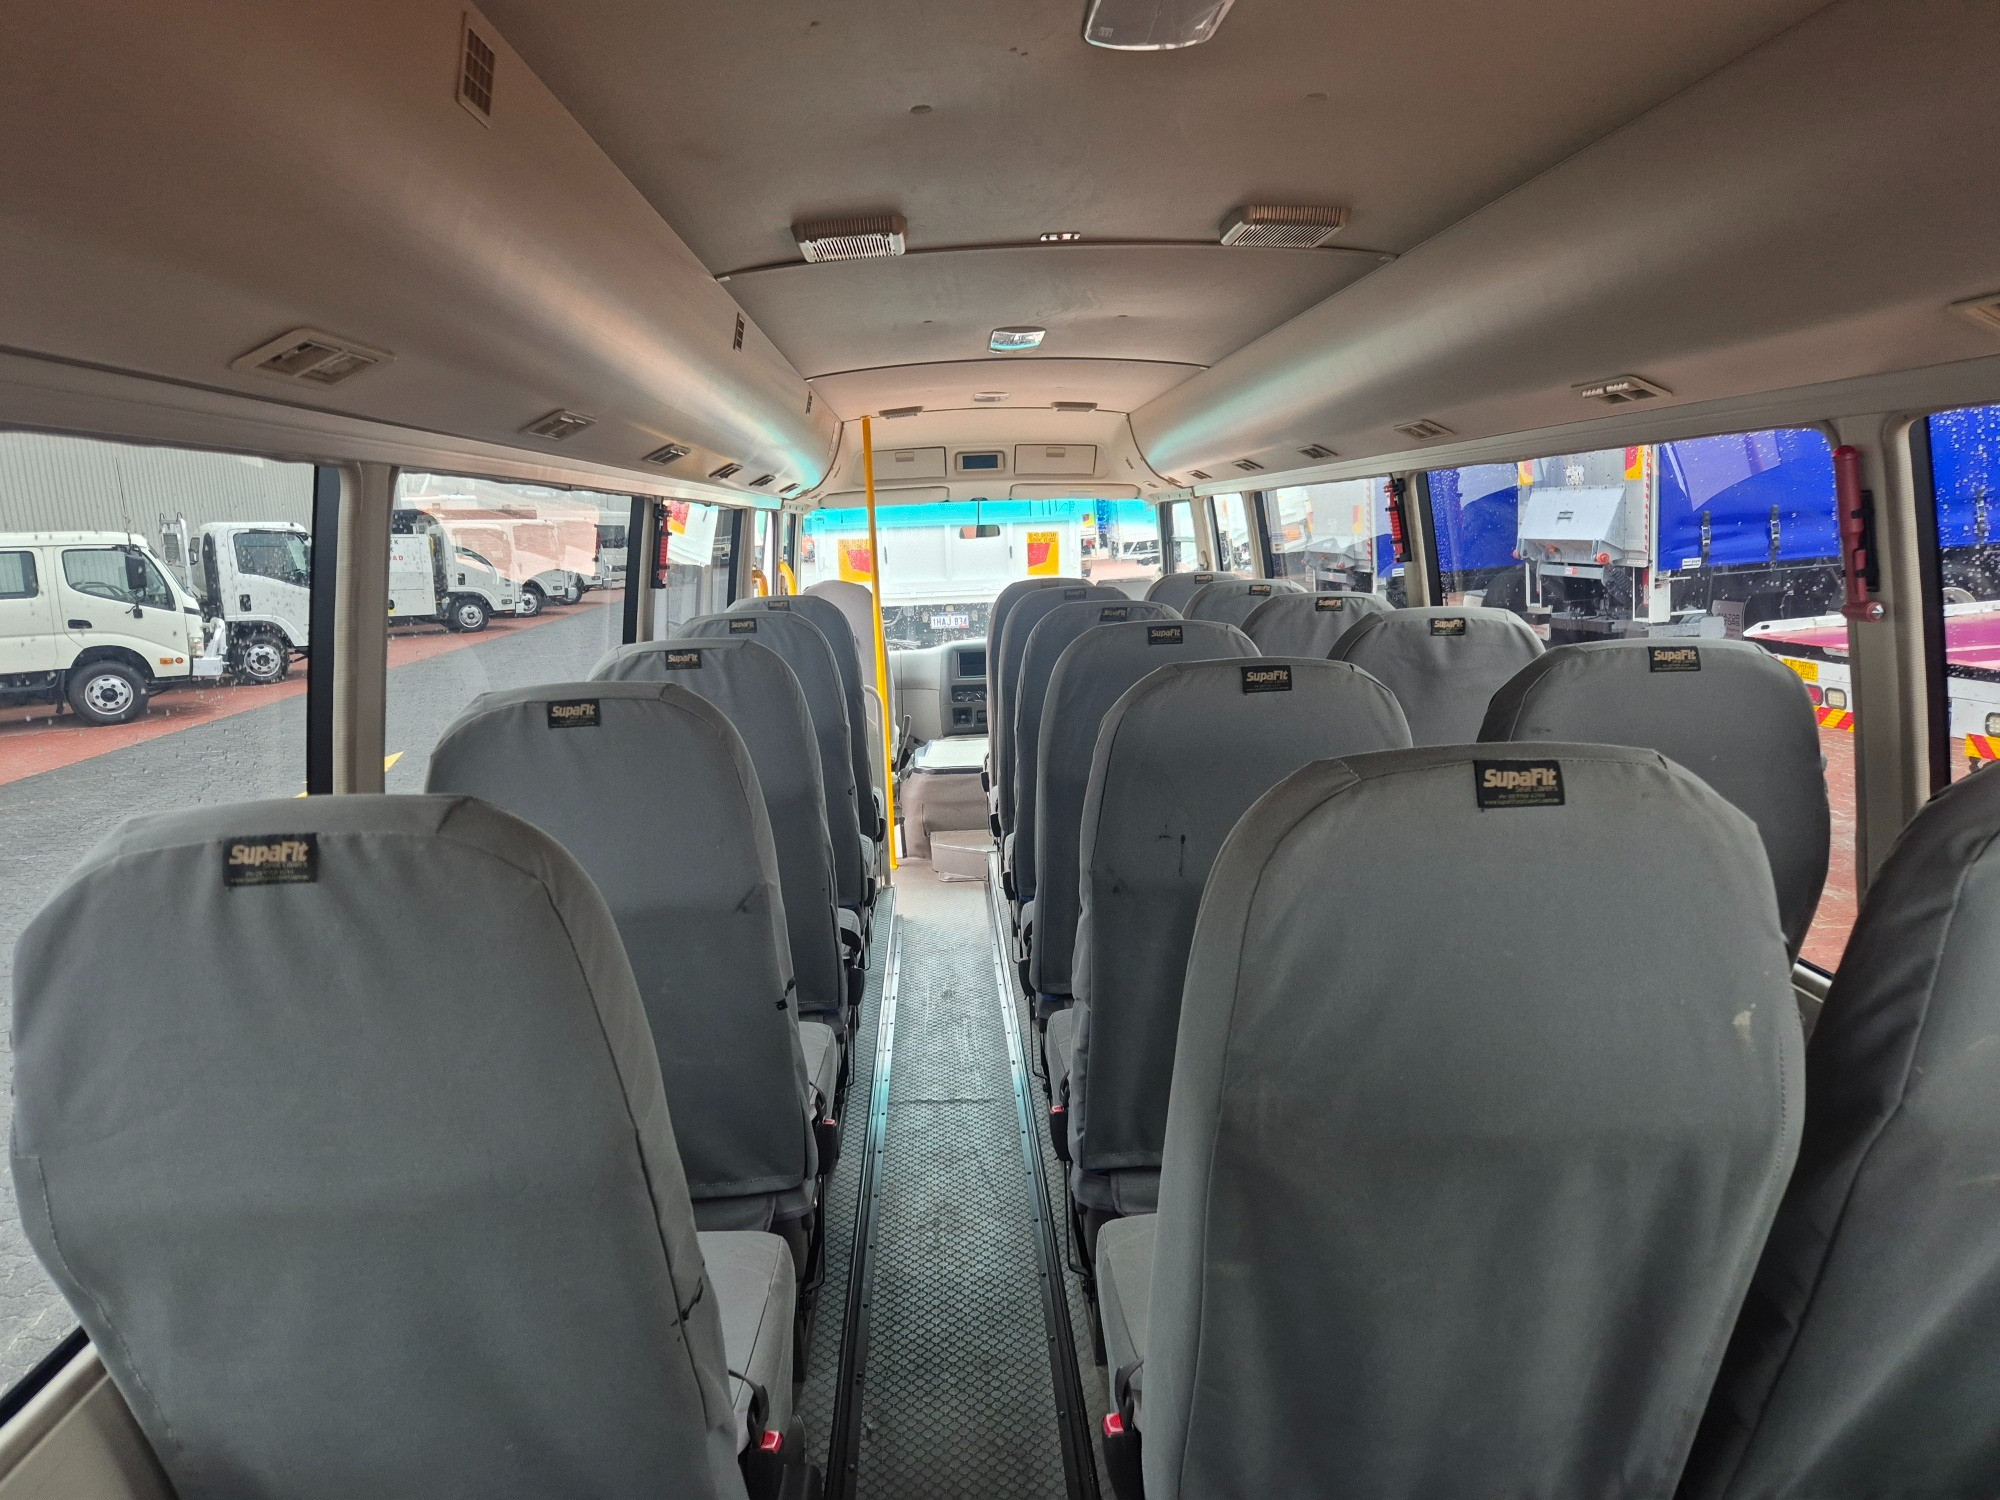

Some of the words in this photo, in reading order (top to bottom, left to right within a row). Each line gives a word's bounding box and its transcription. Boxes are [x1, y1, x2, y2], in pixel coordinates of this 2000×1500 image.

[667, 653, 698, 662] SupaFit
[1653, 649, 1697, 661] SupaFit
[1246, 670, 1289, 682] SupaFit
[551, 703, 596, 718] SupaFit
[1483, 767, 1557, 790] SupaFit
[228, 841, 309, 867] SupaFit
